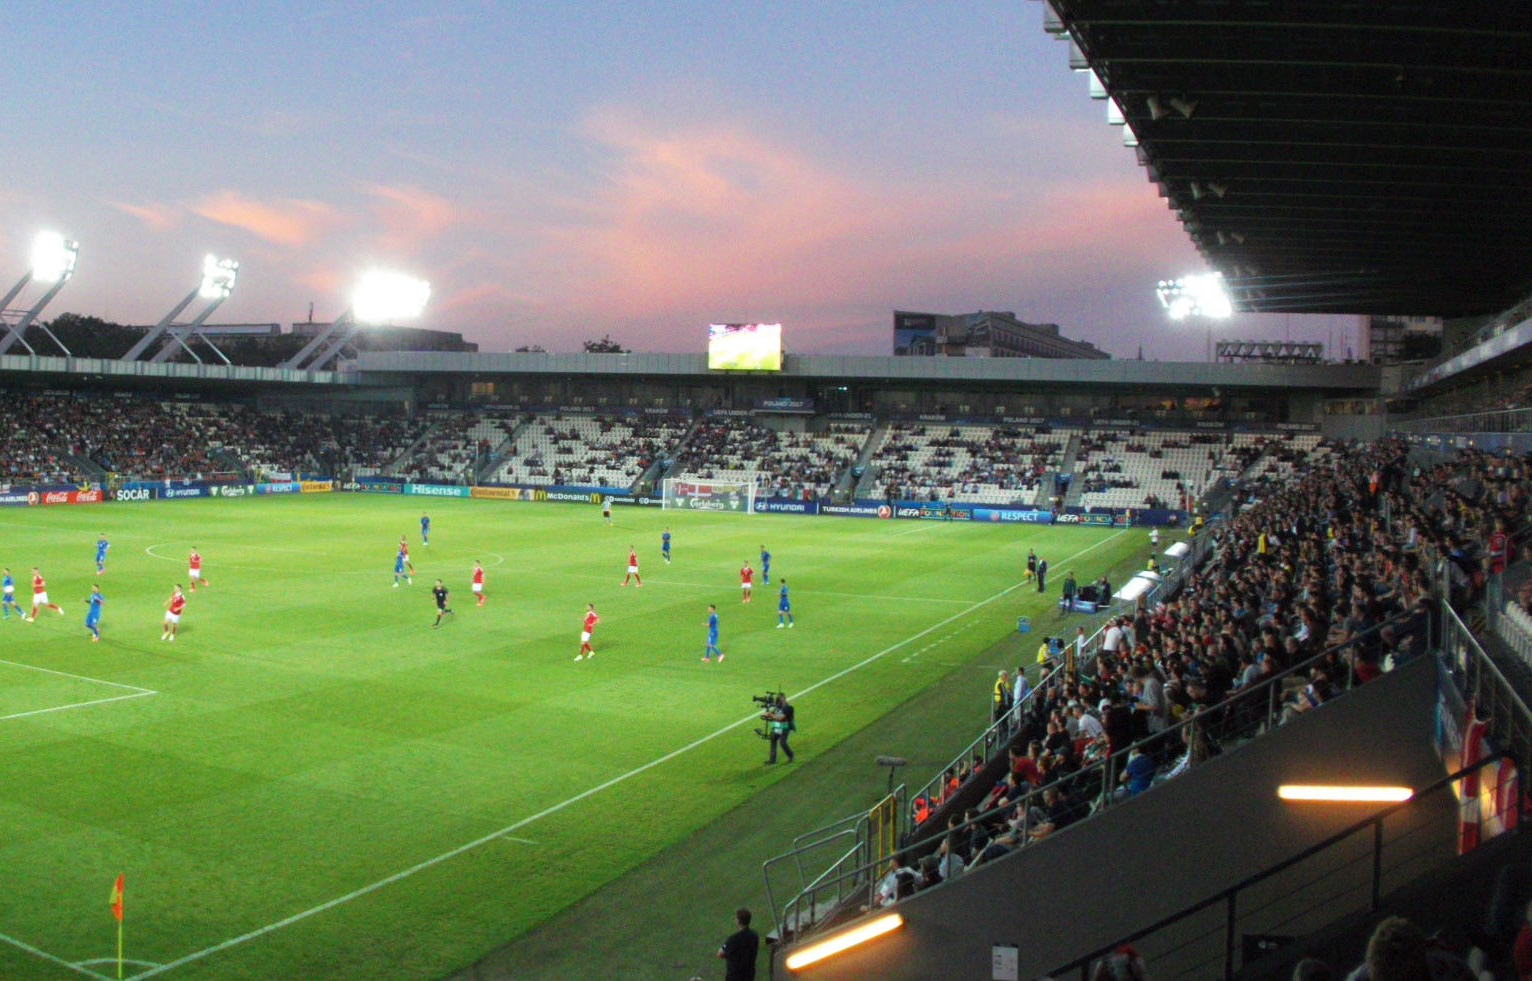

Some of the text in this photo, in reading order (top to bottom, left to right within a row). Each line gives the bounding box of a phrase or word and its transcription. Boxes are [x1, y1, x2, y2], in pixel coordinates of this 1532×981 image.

[412, 484, 461, 496] Hisense
[547, 493, 589, 501] McDonald's
[690, 498, 724, 509] Carlsberg
[898, 508, 919, 516] UEFA
[1002, 512, 1038, 521] RESPECT
[1057, 514, 1078, 522] UEFA
